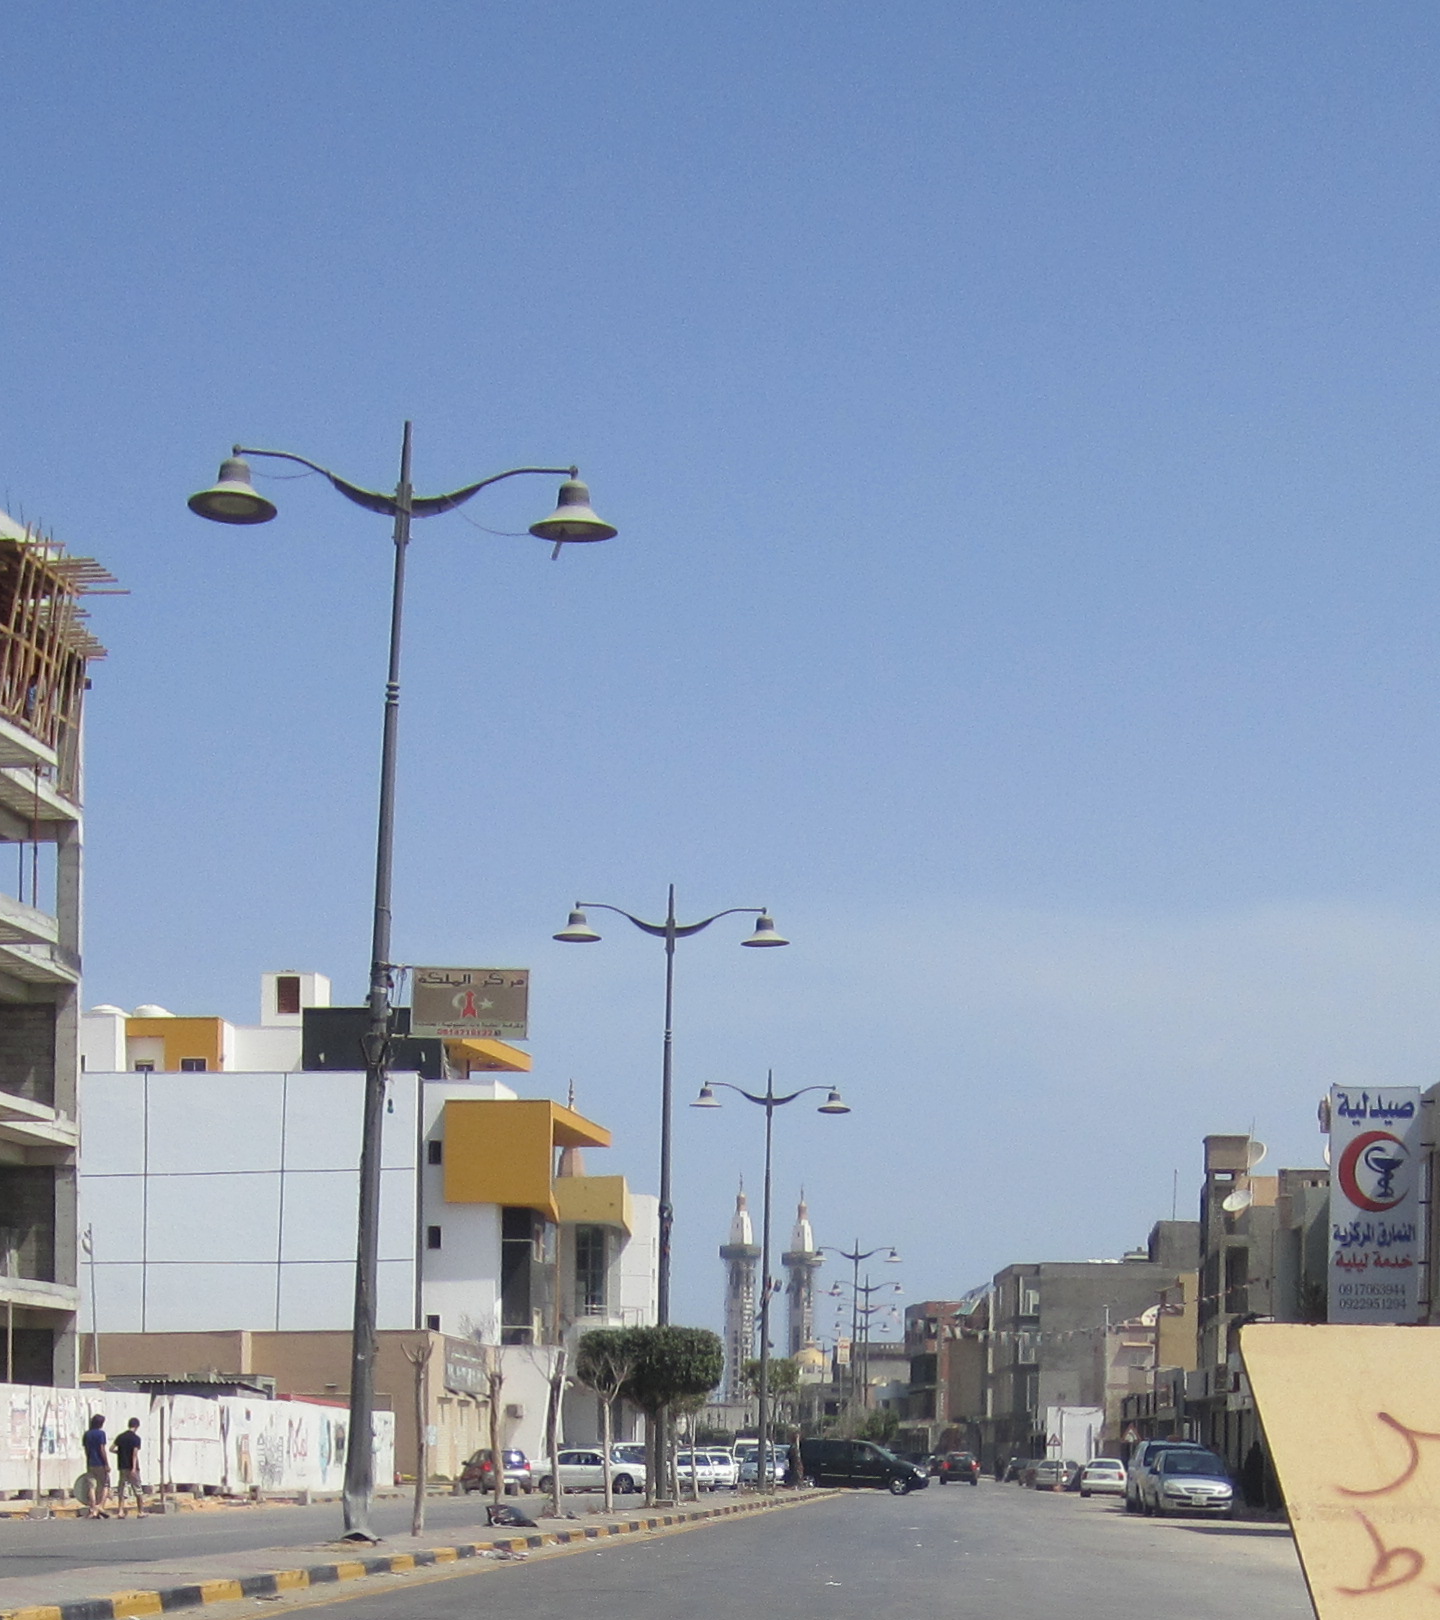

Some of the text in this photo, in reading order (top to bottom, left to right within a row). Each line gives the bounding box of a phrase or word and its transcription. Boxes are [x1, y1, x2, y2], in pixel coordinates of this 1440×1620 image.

[1337, 1091, 1415, 1126] صيدلية
[1333, 1222, 1375, 1248] المركزية
[1335, 1250, 1413, 1273] خدمة ليلية
